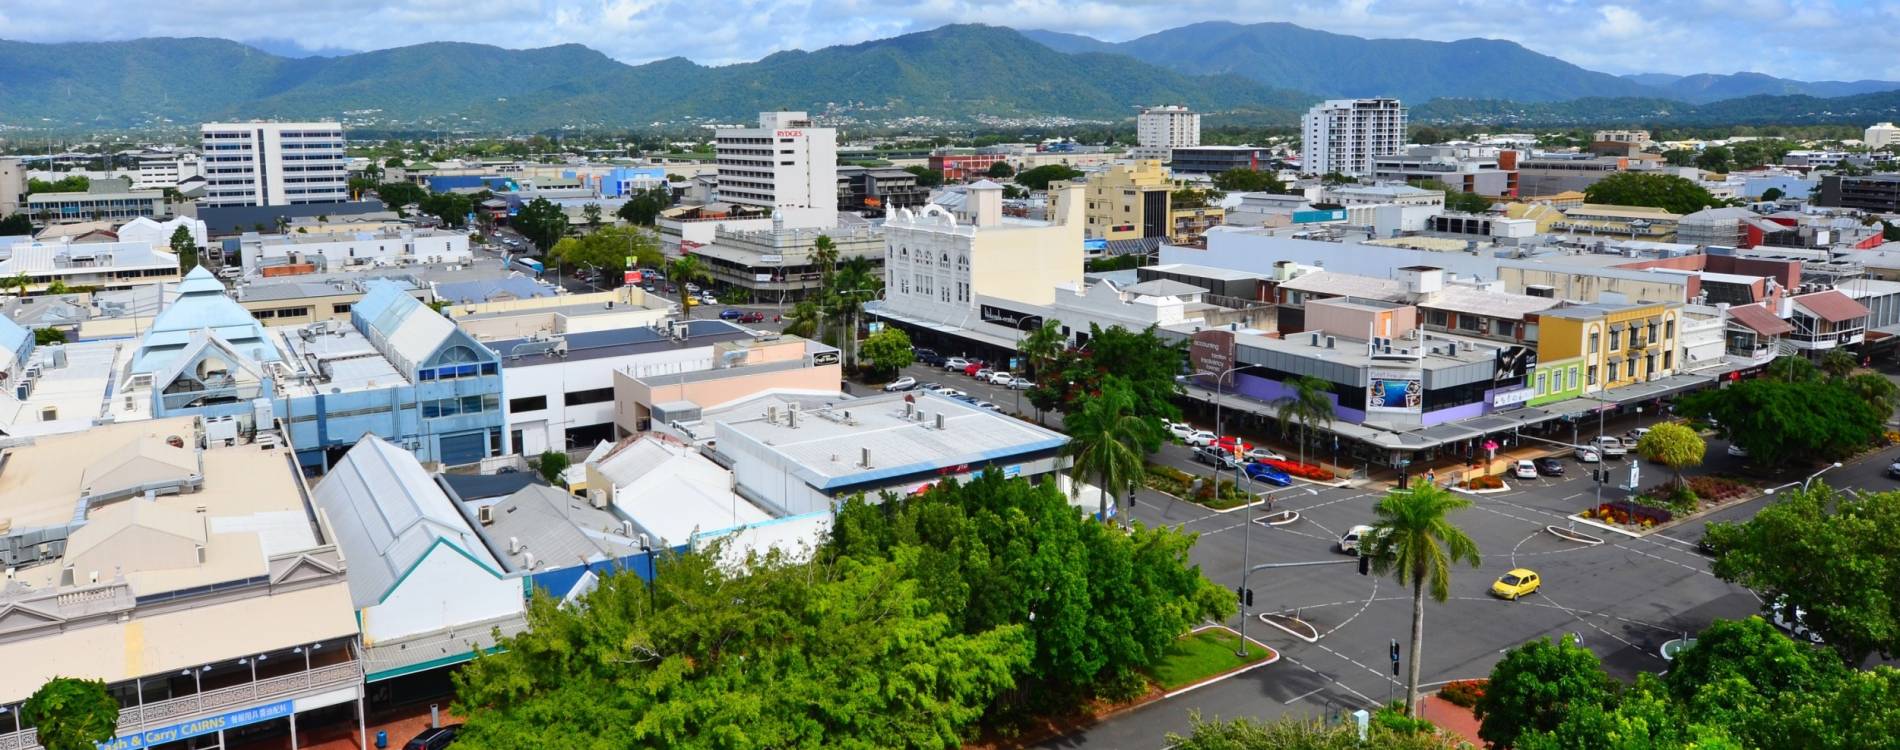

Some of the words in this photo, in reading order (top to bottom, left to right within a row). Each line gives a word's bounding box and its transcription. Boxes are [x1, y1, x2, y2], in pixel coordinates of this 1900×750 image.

[131, 735, 142, 747] &
[146, 729, 177, 743] Carry
[181, 717, 225, 734] CAIRNS
